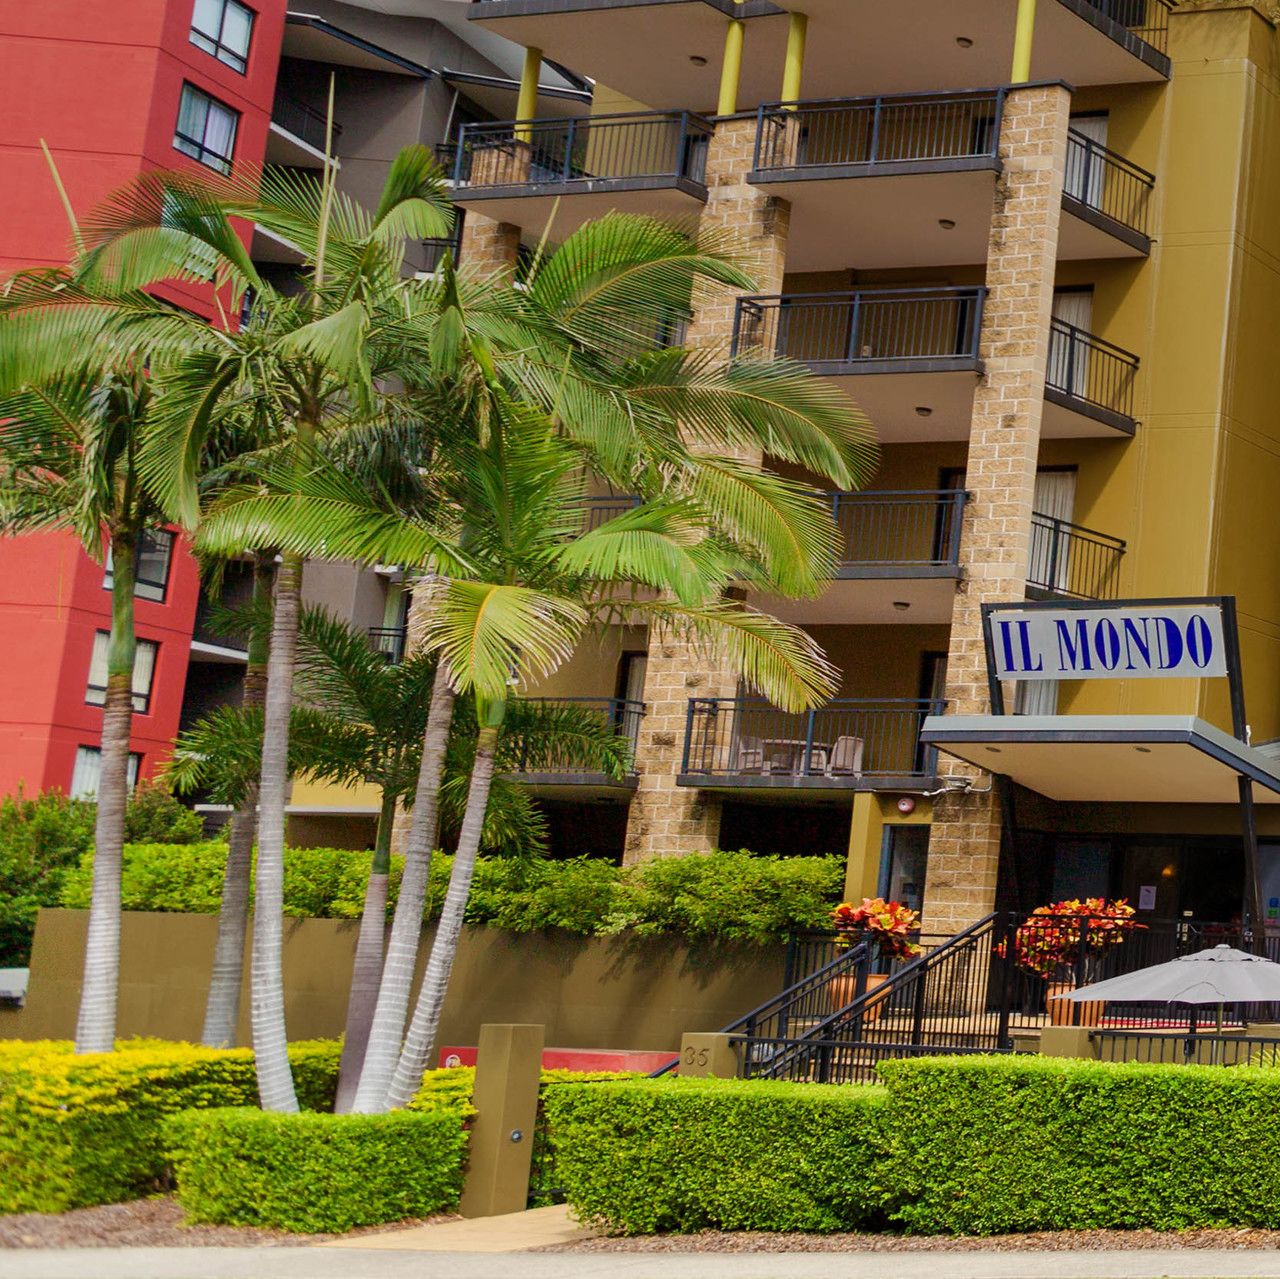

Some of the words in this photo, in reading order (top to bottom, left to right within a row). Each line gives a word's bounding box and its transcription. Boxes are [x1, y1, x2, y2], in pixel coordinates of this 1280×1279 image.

[997, 620, 1043, 672] IL
[1053, 614, 1213, 671] MONDO
[685, 1046, 710, 1066] 35
